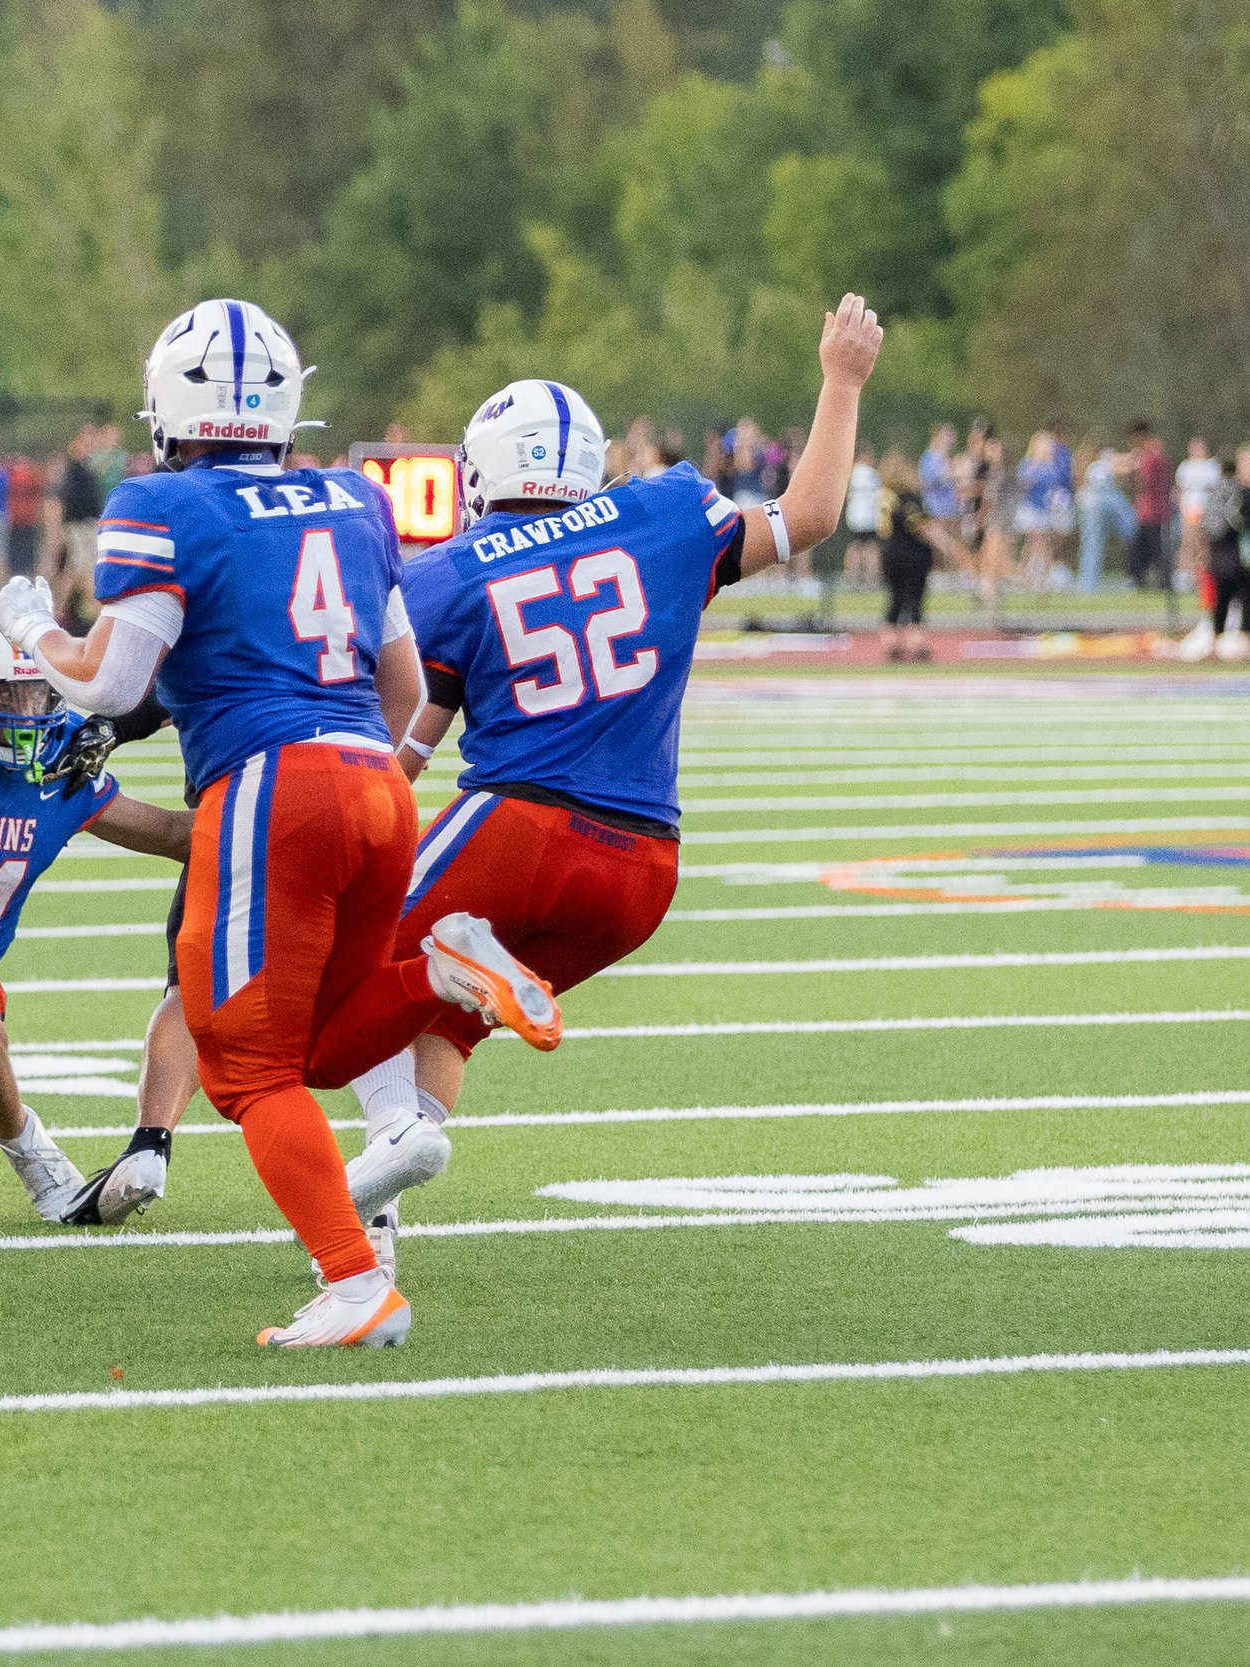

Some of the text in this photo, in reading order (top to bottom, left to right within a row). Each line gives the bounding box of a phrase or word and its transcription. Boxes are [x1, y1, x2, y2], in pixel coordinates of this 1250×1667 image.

[199, 422, 269, 439] Riddell
[533, 448, 545, 457] 52
[236, 480, 365, 519] LEA
[362, 456, 456, 538] 40
[522, 481, 588, 500] Riddell
[472, 496, 620, 563] CRAWFORD
[287, 527, 359, 685] 4
[485, 546, 659, 717] 52
